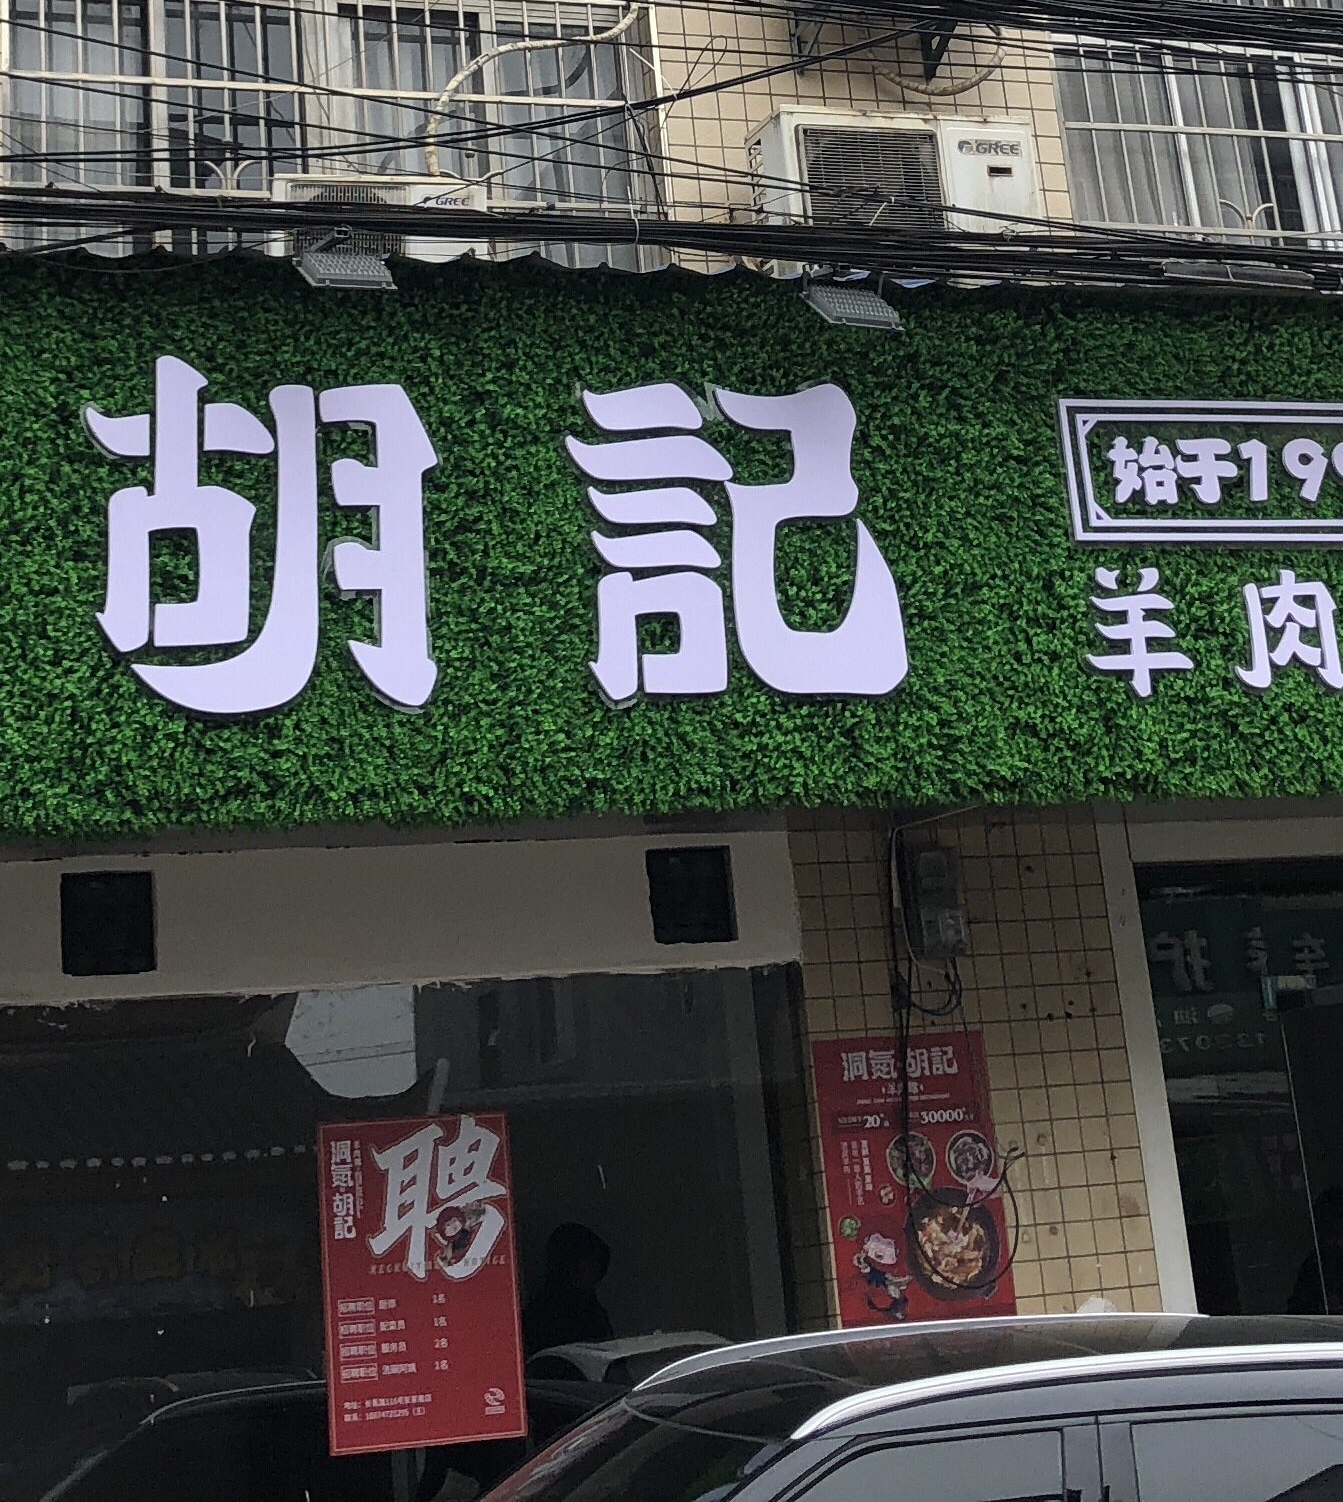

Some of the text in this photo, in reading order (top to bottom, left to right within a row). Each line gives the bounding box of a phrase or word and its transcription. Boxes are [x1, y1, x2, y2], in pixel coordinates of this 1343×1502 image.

[976, 143, 1020, 155] GREE
[436, 195, 470, 207] GREE
[370, 1114, 506, 1279] 聘
